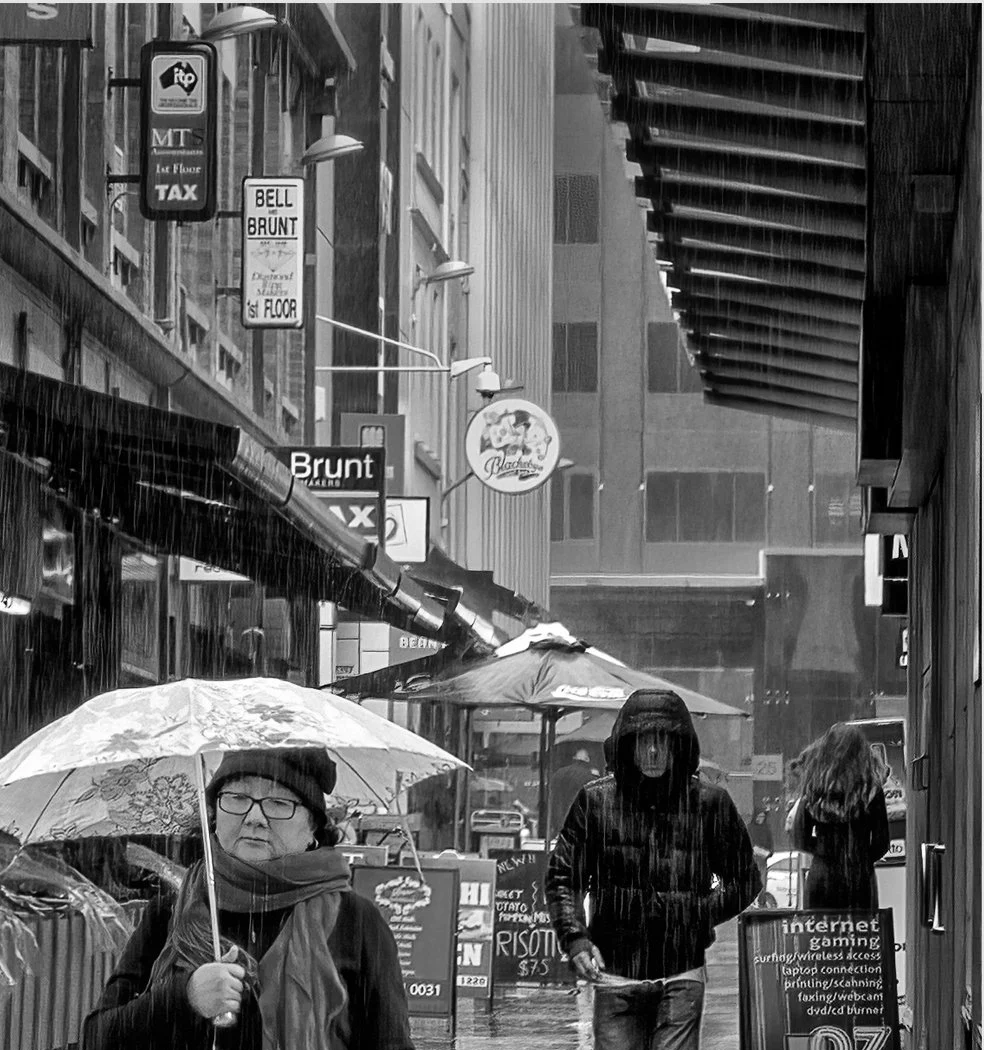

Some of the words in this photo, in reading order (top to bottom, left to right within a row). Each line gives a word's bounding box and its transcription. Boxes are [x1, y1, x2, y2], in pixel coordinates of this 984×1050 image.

[173, 67, 195, 88] itp
[172, 163, 201, 174] Floor
[154, 184, 198, 201] TAX
[255, 189, 293, 208] BELL
[247, 217, 298, 236] BRUNT
[264, 299, 297, 318] FLOOR
[291, 451, 374, 479] Brunt
[782, 919, 881, 934] internet
[810, 934, 881, 951] gaming
[754, 951, 844, 964] surfing/wireless
[846, 950, 881, 961] access
[782, 966, 818, 978] laptop
[820, 964, 882, 975] connection
[409, 984, 441, 996] 0031
[784, 977, 883, 990] printing/scanning
[798, 991, 884, 1004] faxing/webcam
[807, 1005, 844, 1016] dvd/cd
[847, 1005, 884, 1016] burner
